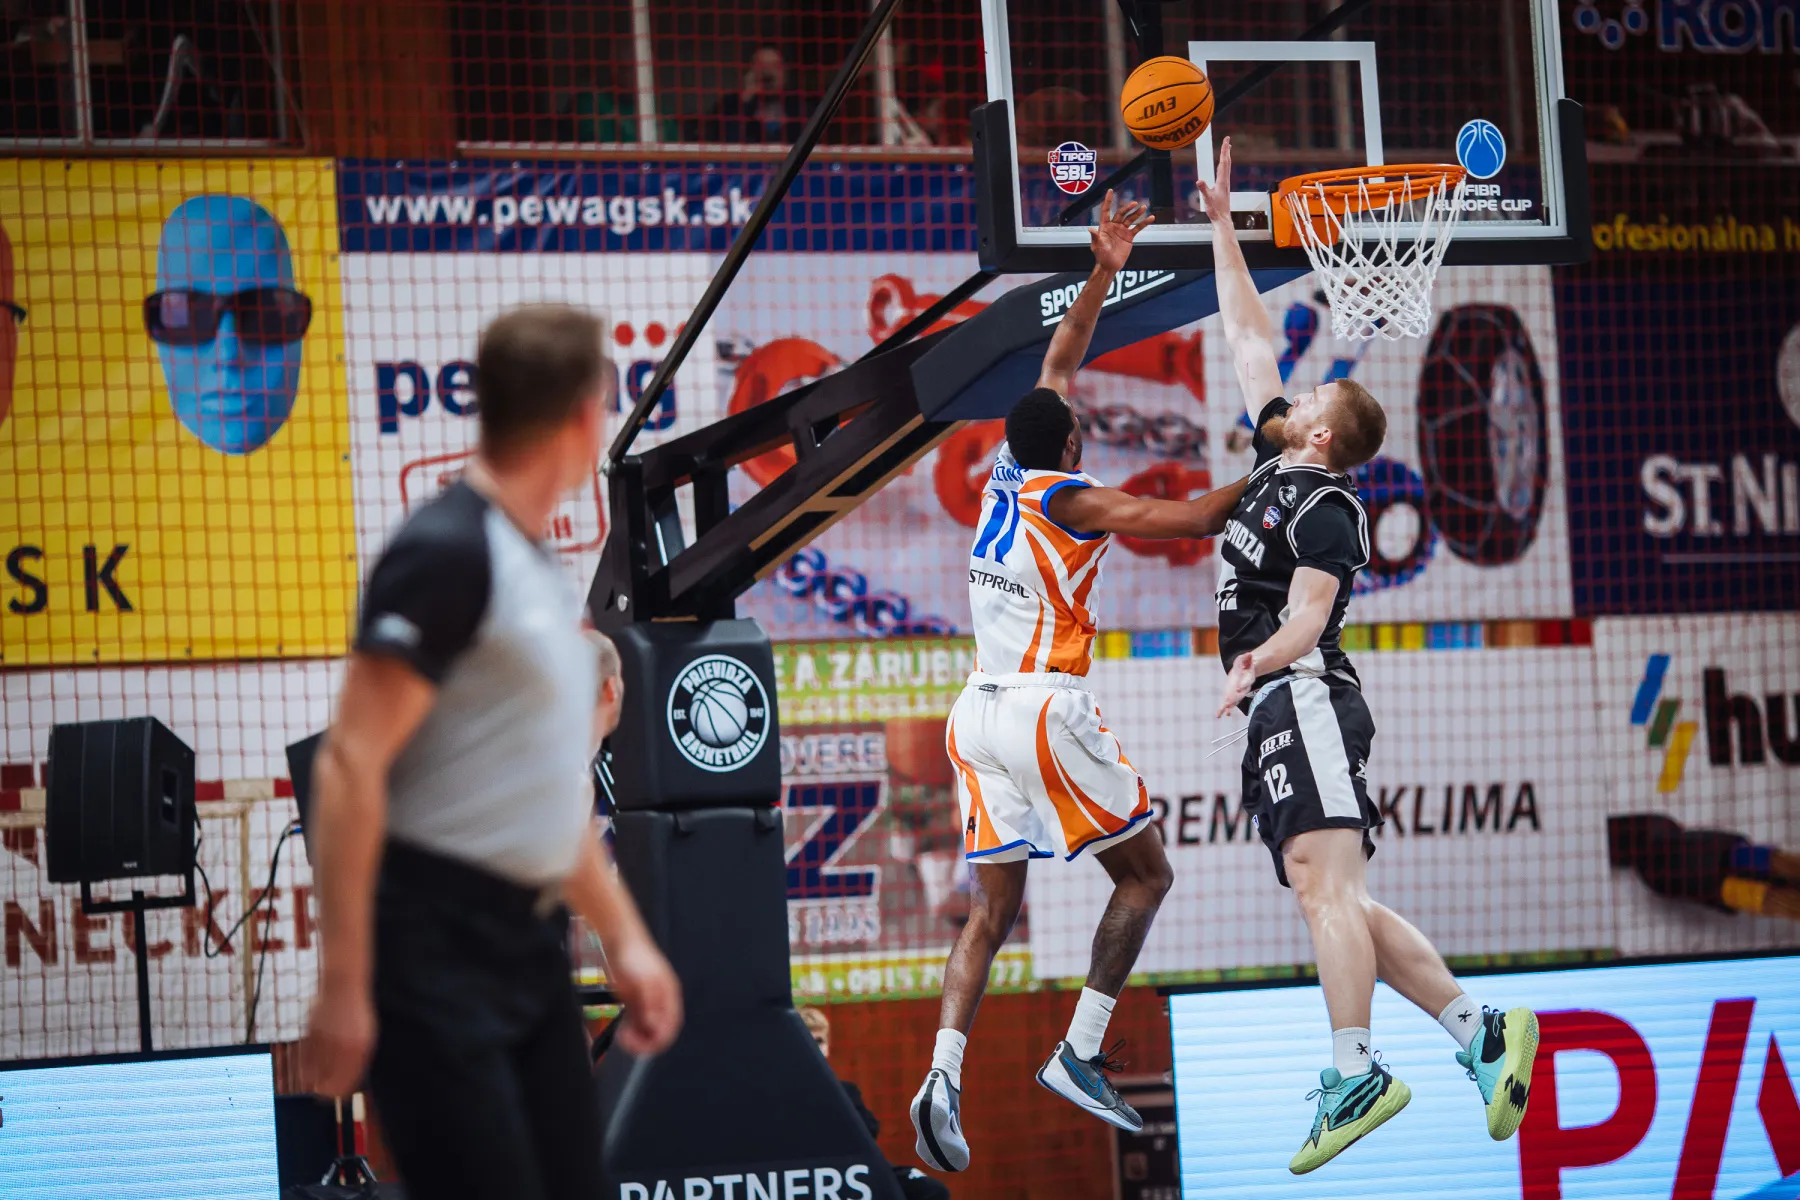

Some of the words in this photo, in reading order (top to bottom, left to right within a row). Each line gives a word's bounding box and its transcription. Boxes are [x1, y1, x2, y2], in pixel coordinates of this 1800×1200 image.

[1143, 96, 1177, 119] EVO
[1055, 165, 1092, 181] SBL
[1061, 152, 1094, 162] TIPOS
[1464, 184, 1501, 196] FIBA
[1501, 199, 1533, 212] CUP
[365, 186, 754, 236] www.pewagsk.sk
[375, 359, 677, 434] peg
[680, 661, 754, 695] PRIEVIDZA
[680, 730, 760, 766] BASKETBALL
[1264, 763, 1294, 804] 12
[1376, 781, 1542, 838] KLIMA
